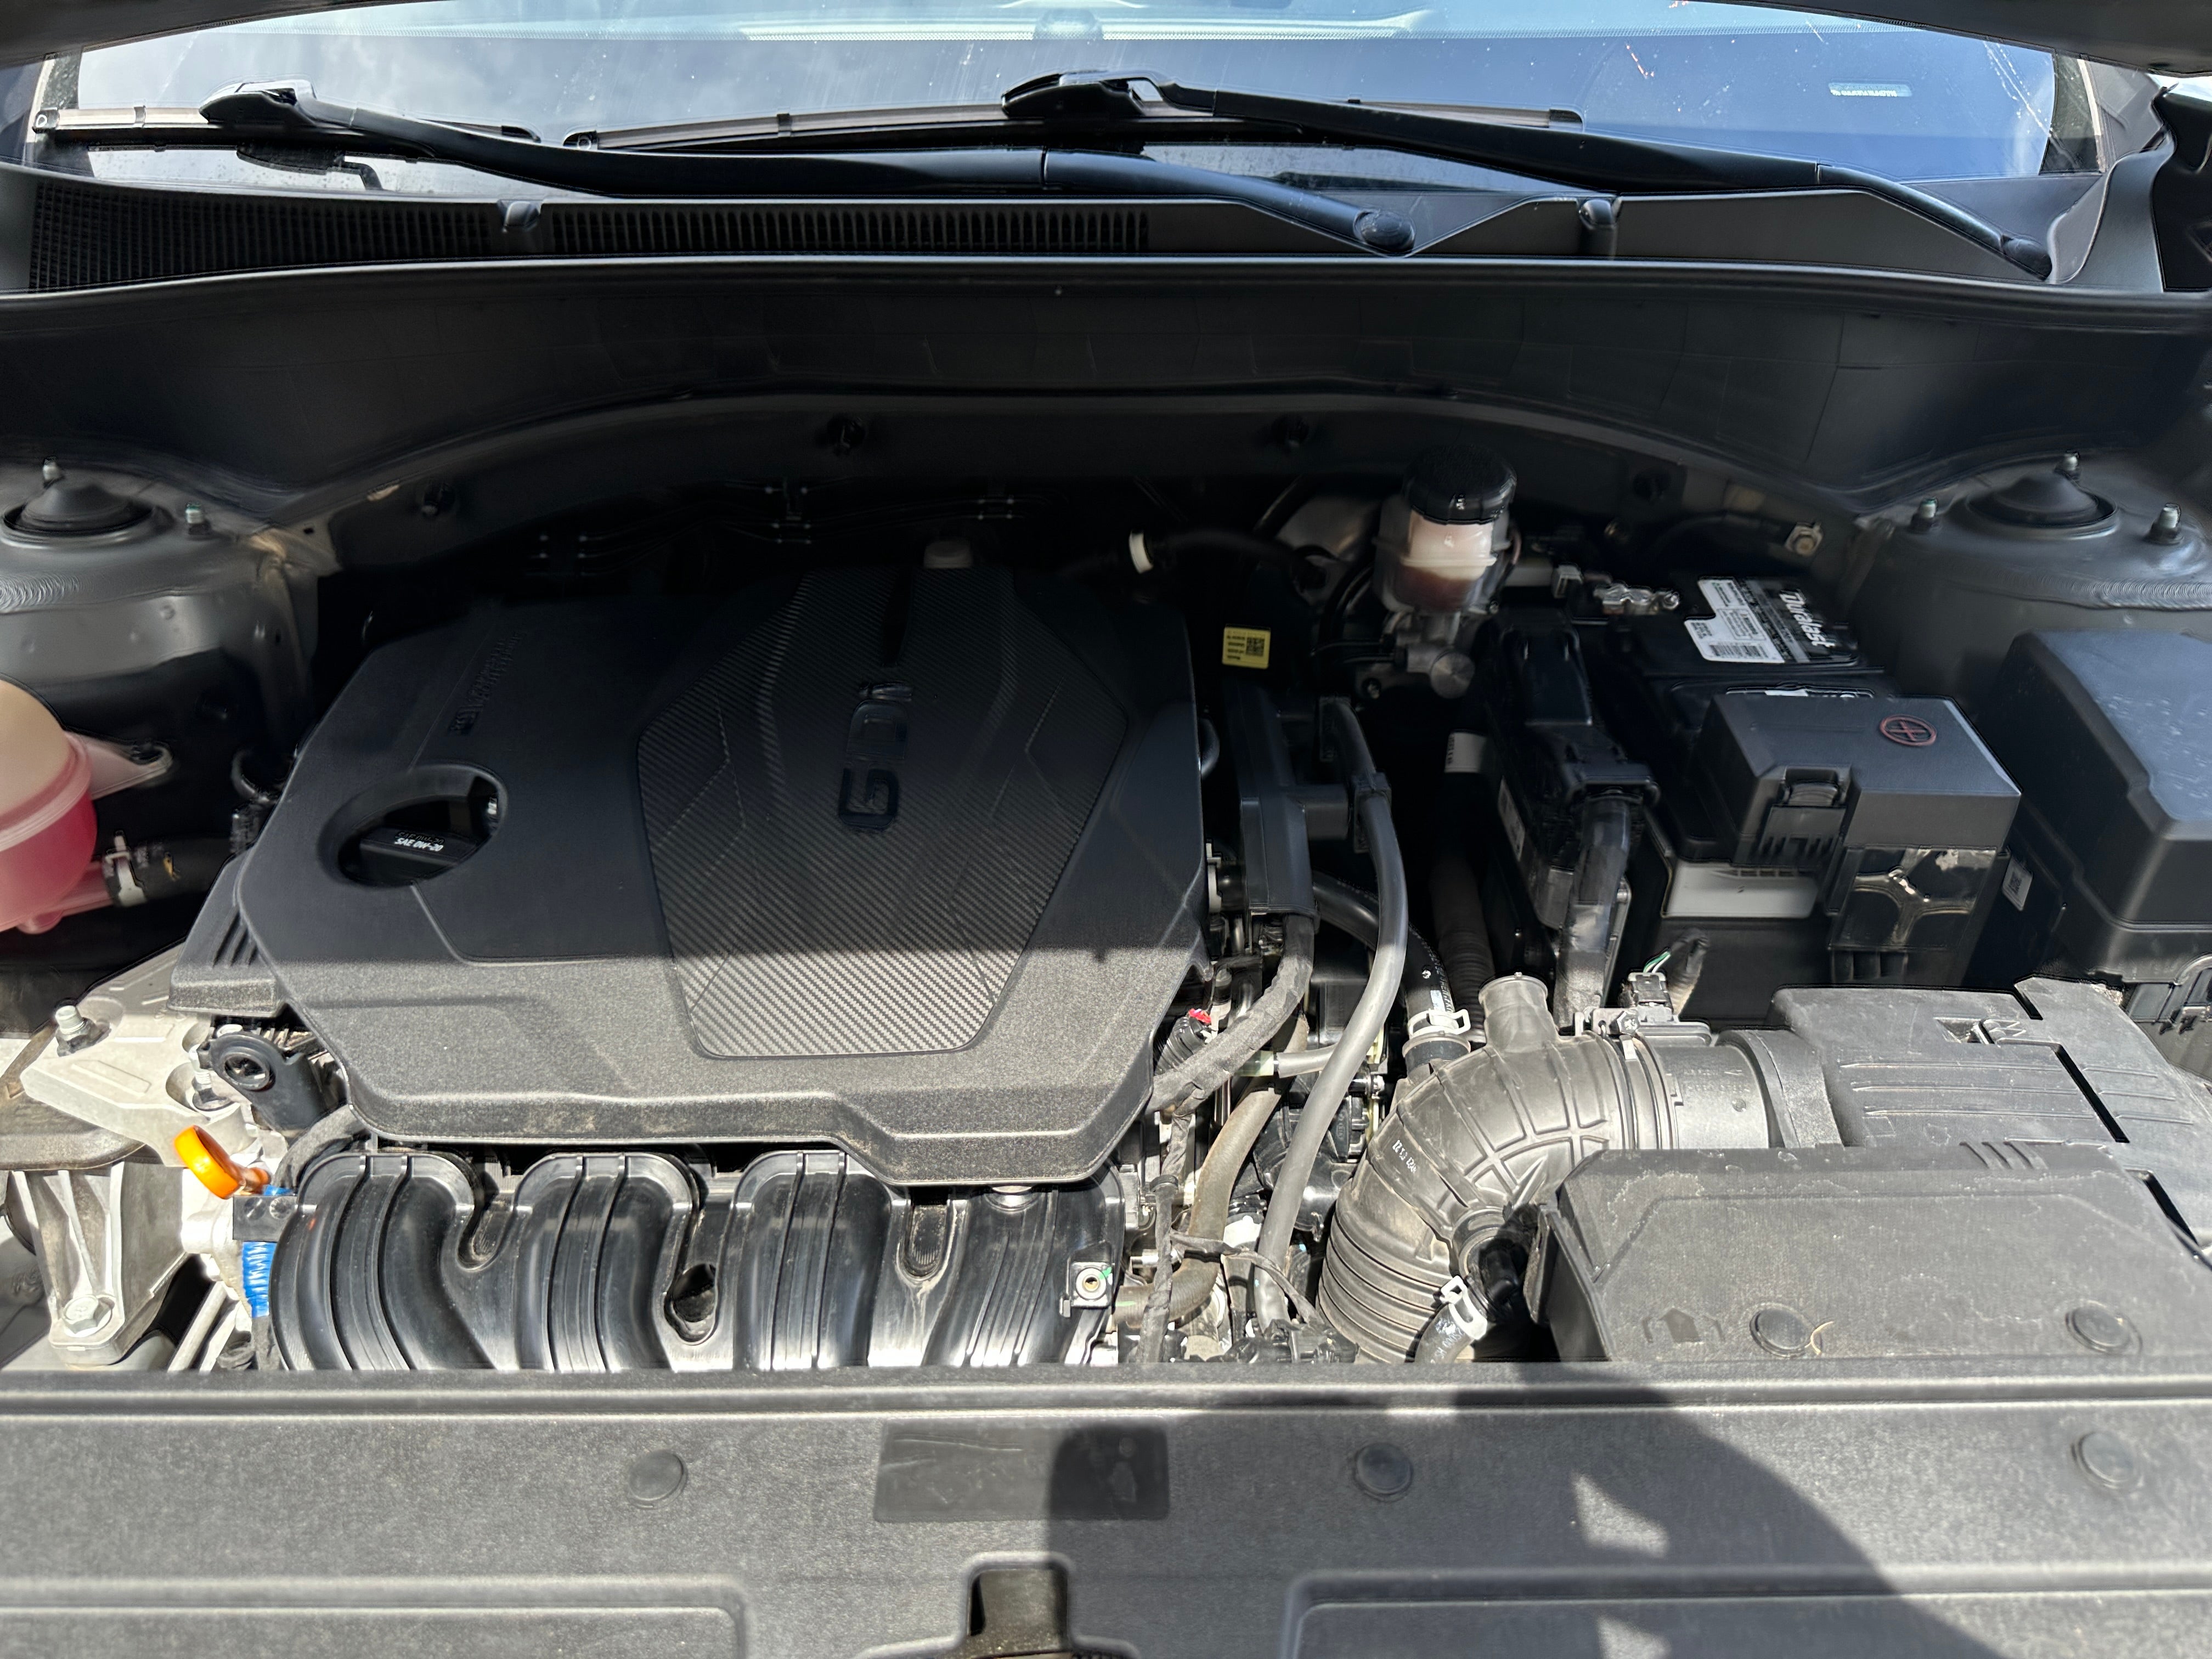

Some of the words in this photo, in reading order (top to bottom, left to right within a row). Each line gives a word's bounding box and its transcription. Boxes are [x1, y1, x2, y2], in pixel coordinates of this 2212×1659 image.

[1779, 592, 1836, 647] Duralast
[394, 838, 416, 847] SAE
[413, 840, 444, 851] 0W-20
